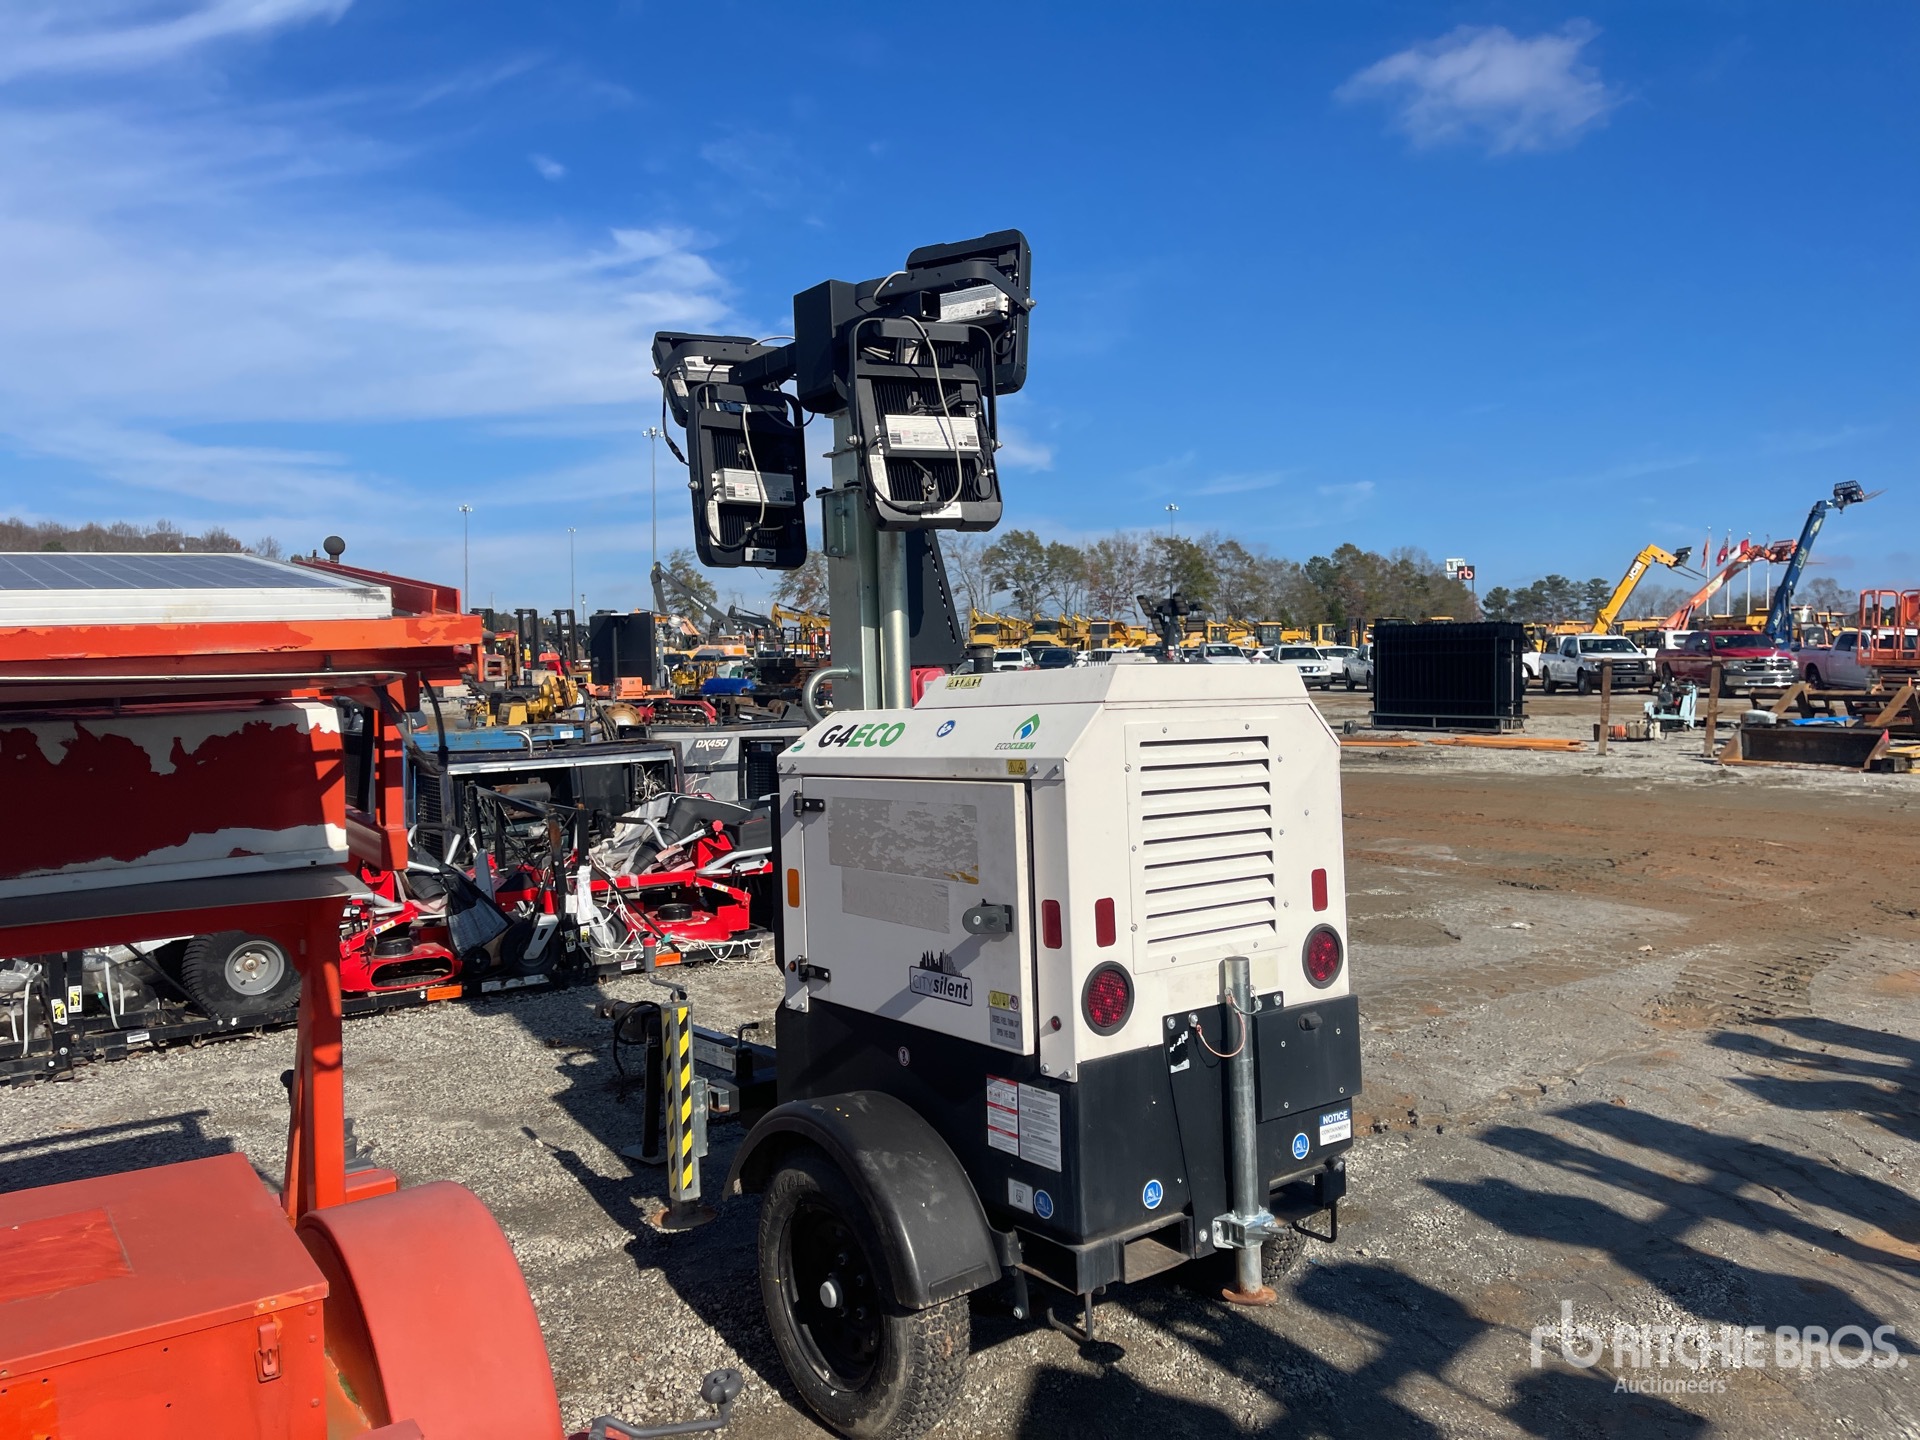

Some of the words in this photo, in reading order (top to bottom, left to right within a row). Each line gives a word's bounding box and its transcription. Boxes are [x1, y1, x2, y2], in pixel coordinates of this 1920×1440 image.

[1459, 566, 1474, 580] rb
[818, 722, 906, 748] G4ECO
[695, 738, 729, 752] DX450
[994, 741, 1037, 750] ECOCLEAN
[912, 974, 969, 1000] CITYsilent
[1322, 1110, 1348, 1125] NOTICE
